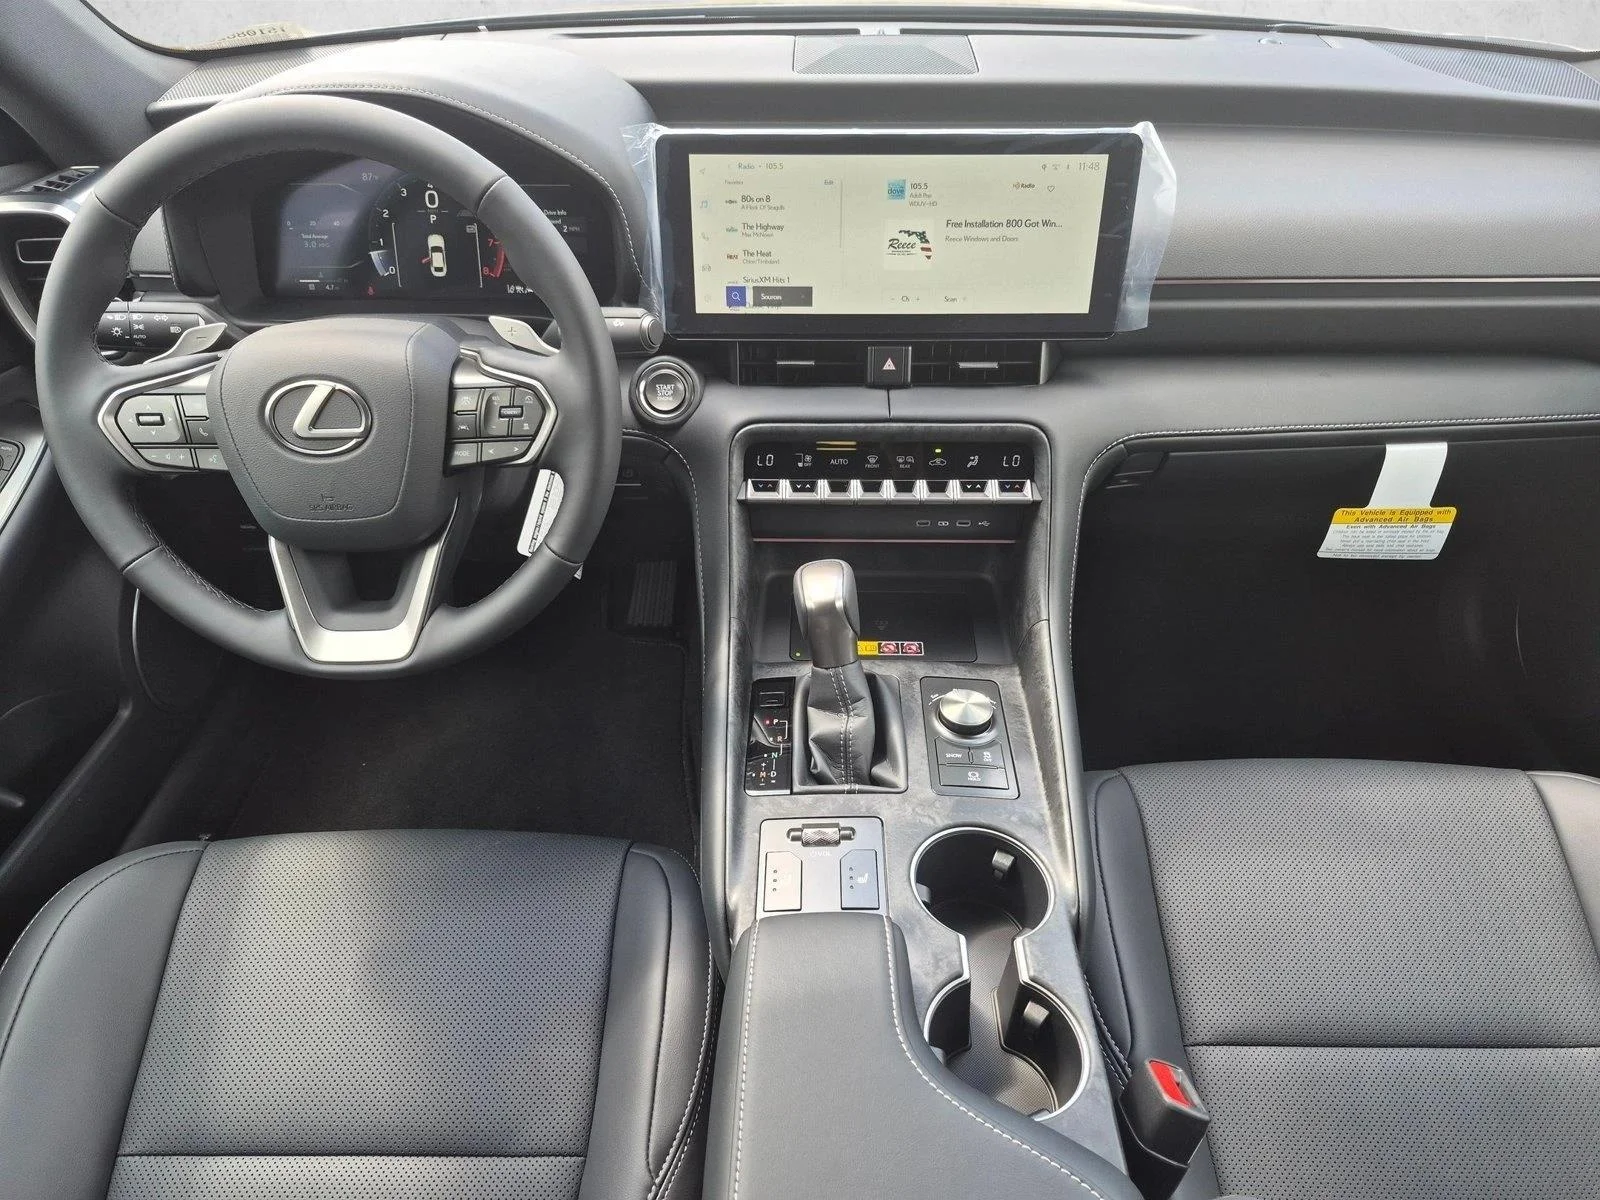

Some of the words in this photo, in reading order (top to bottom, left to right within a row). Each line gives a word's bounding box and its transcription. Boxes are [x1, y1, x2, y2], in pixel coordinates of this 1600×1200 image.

[1079, 162, 1100, 170] 11:48
[400, 188, 407, 196] 3
[425, 190, 439, 208] 0
[741, 194, 754, 202] 80s
[765, 194, 771, 202] 8
[383, 209, 389, 218] 2
[430, 214, 437, 224] P
[946, 220, 963, 228] Free
[964, 220, 1003, 228] Installation
[1006, 219, 1022, 228] 800
[1024, 220, 1038, 228] Got
[1041, 220, 1063, 228] Win...
[756, 222, 784, 232] Highway
[380, 238, 384, 246] 1
[488, 238, 494, 247] 7
[888, 238, 916, 250] Reece
[390, 266, 395, 275] 0
[483, 267, 489, 275] 8
[757, 454, 774, 467] LO
[1003, 455, 1020, 467] LO
